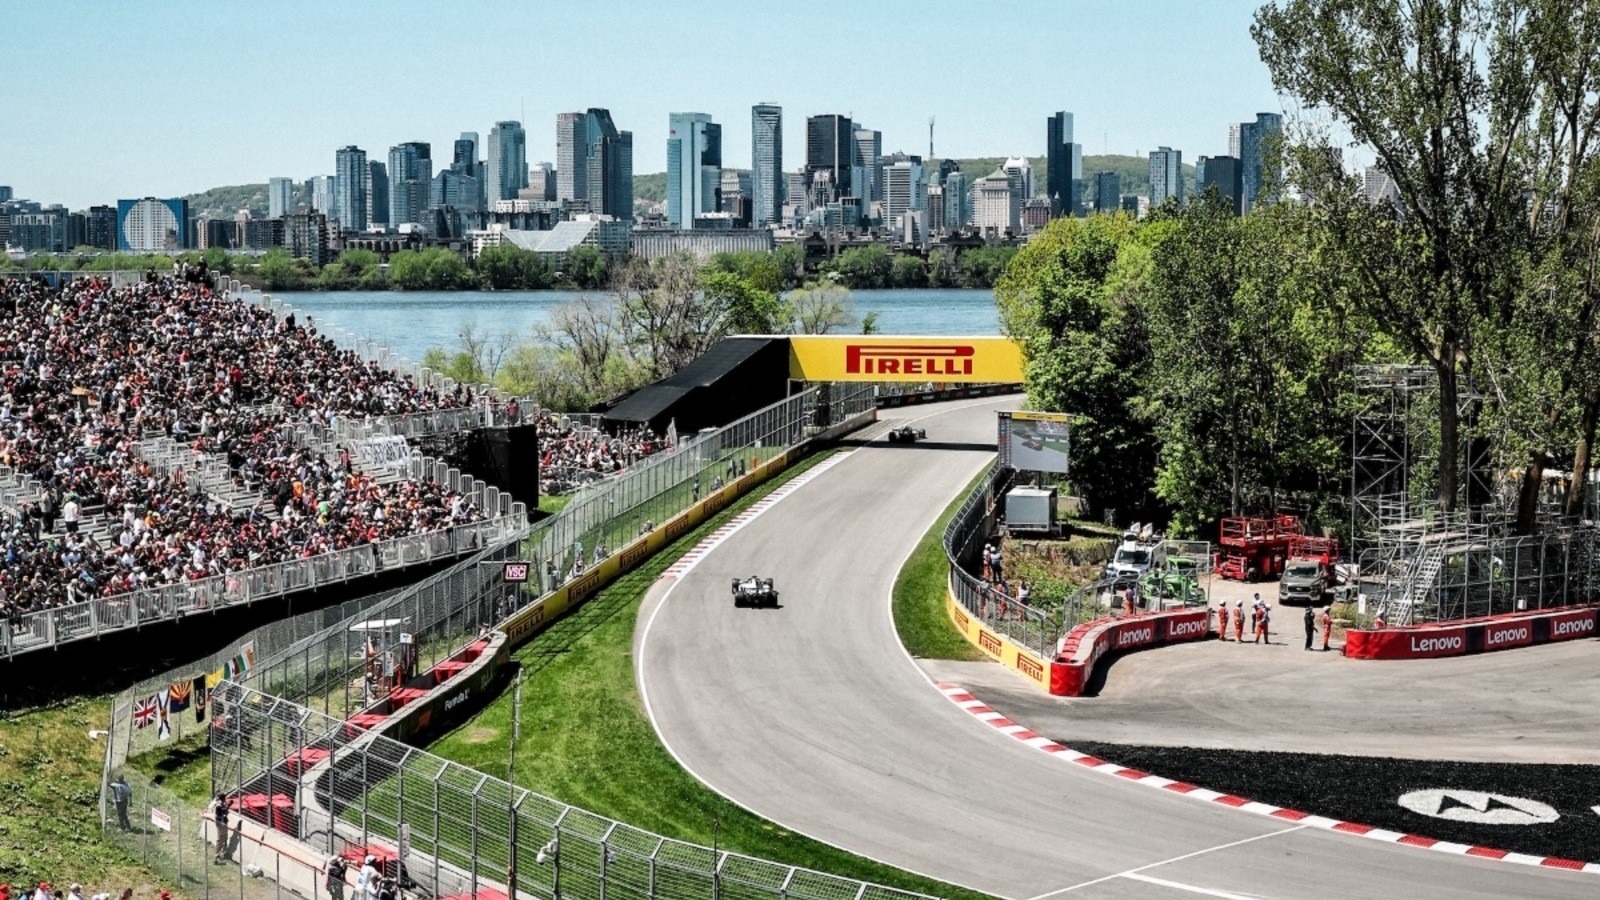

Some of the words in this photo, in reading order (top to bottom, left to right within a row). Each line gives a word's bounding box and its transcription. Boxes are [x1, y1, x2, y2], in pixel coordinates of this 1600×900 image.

[846, 345, 975, 375] PIRELLI
[508, 566, 525, 578] VSC
[567, 569, 600, 602] PIRELLI
[506, 605, 544, 640] PIRELLI
[1169, 619, 1208, 636] Lenovo
[1554, 618, 1594, 635] Lenovo
[979, 629, 1002, 657] PIRELLI
[1119, 626, 1152, 645] Lenovo
[1411, 636, 1462, 652] Lenovo
[1487, 627, 1528, 645] Lenovo
[1017, 652, 1044, 682] PIRELLI
